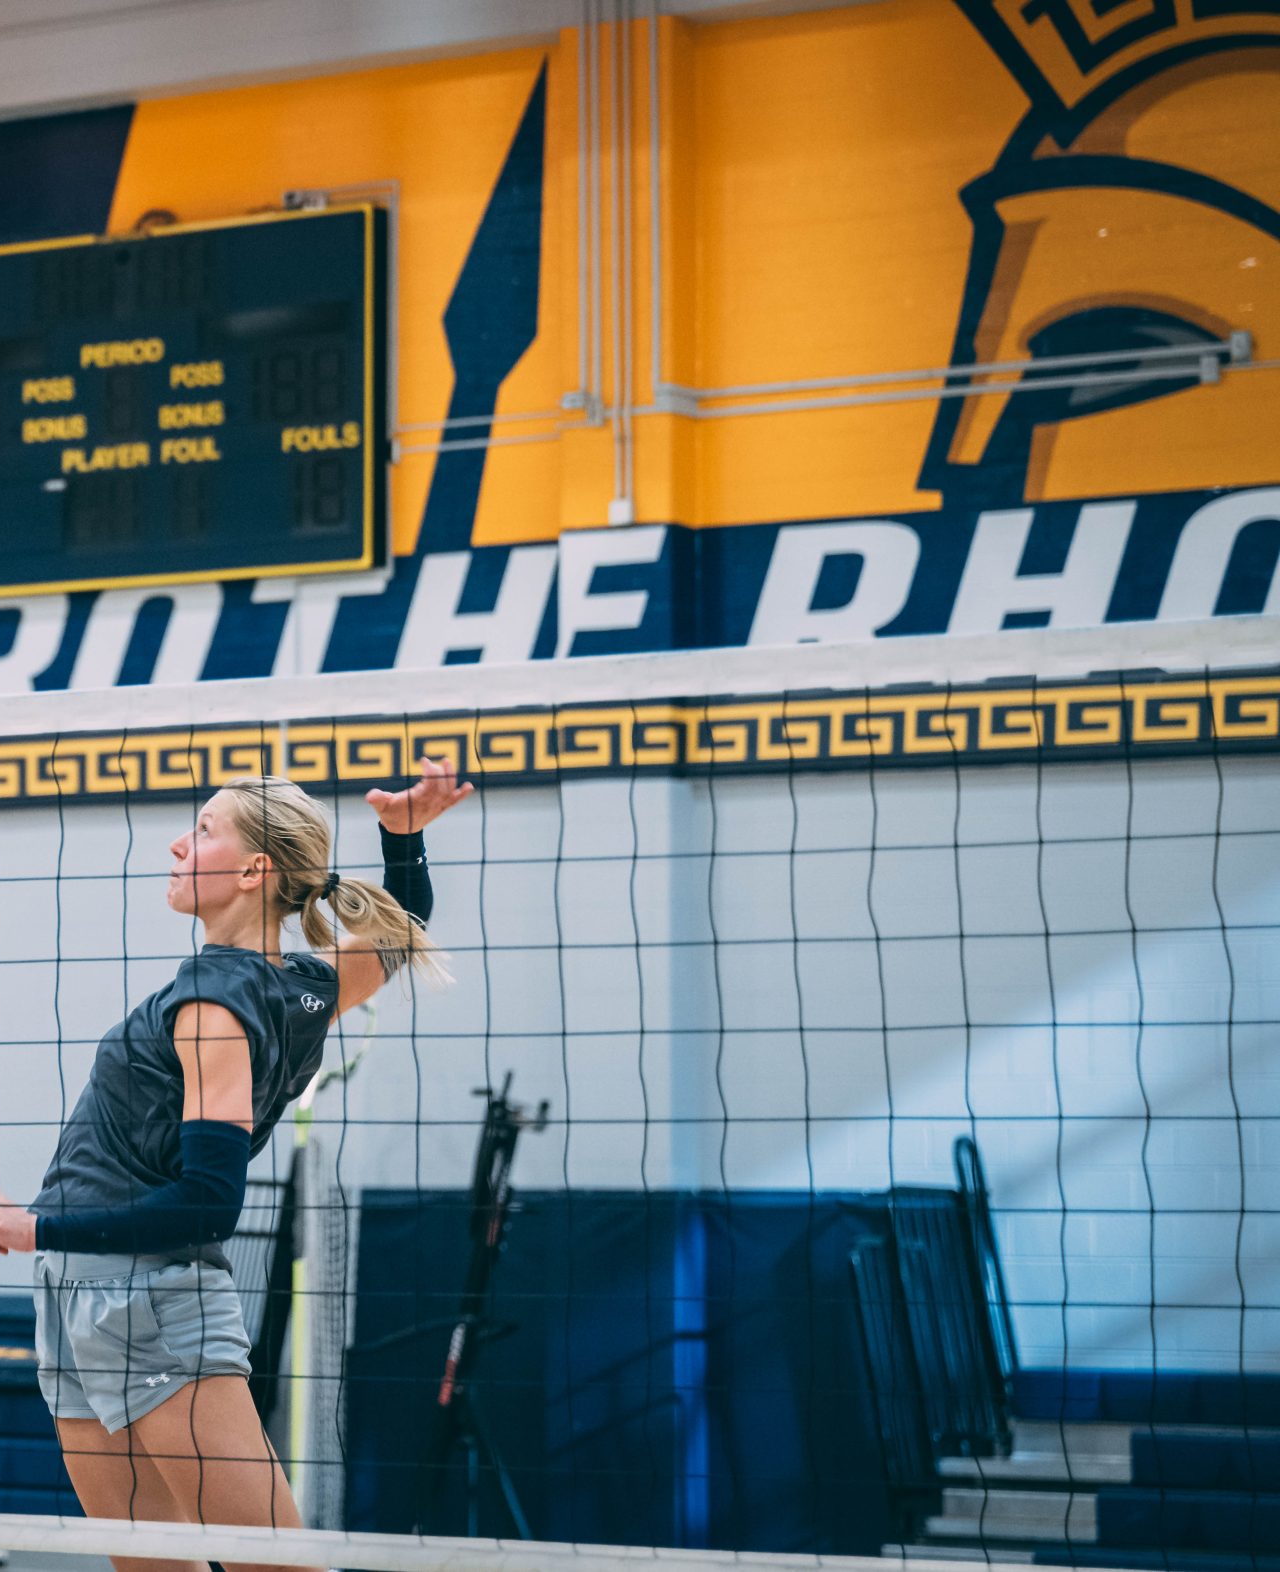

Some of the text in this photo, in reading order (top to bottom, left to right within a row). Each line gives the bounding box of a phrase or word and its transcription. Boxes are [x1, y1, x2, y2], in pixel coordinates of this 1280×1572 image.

[80, 338, 165, 368] PERIOD
[170, 361, 224, 388] POSS
[22, 376, 74, 404] POSS
[22, 415, 87, 443] BONUS
[158, 401, 224, 429] BONUS
[281, 422, 360, 452] FOULS
[61, 437, 221, 473] PLAYER FOUL
